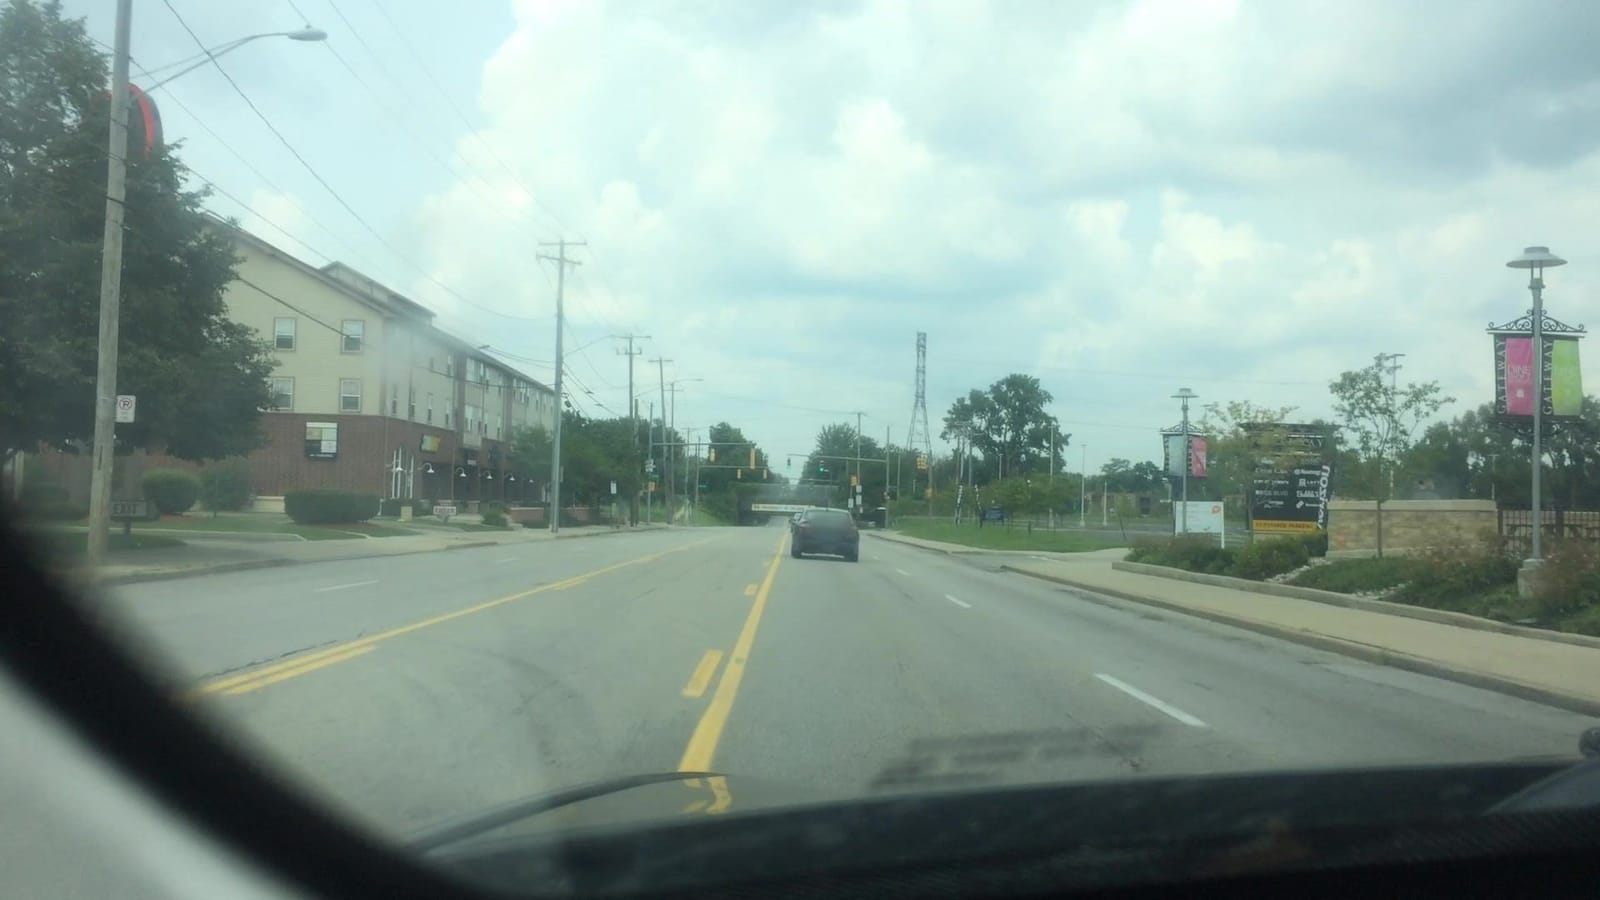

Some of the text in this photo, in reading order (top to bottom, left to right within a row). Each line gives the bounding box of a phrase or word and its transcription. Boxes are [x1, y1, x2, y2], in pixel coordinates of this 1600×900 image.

[1496, 338, 1506, 414] GATEWAY
[1543, 339, 1553, 415] GATEWAY
[113, 503, 138, 514] EXIT
